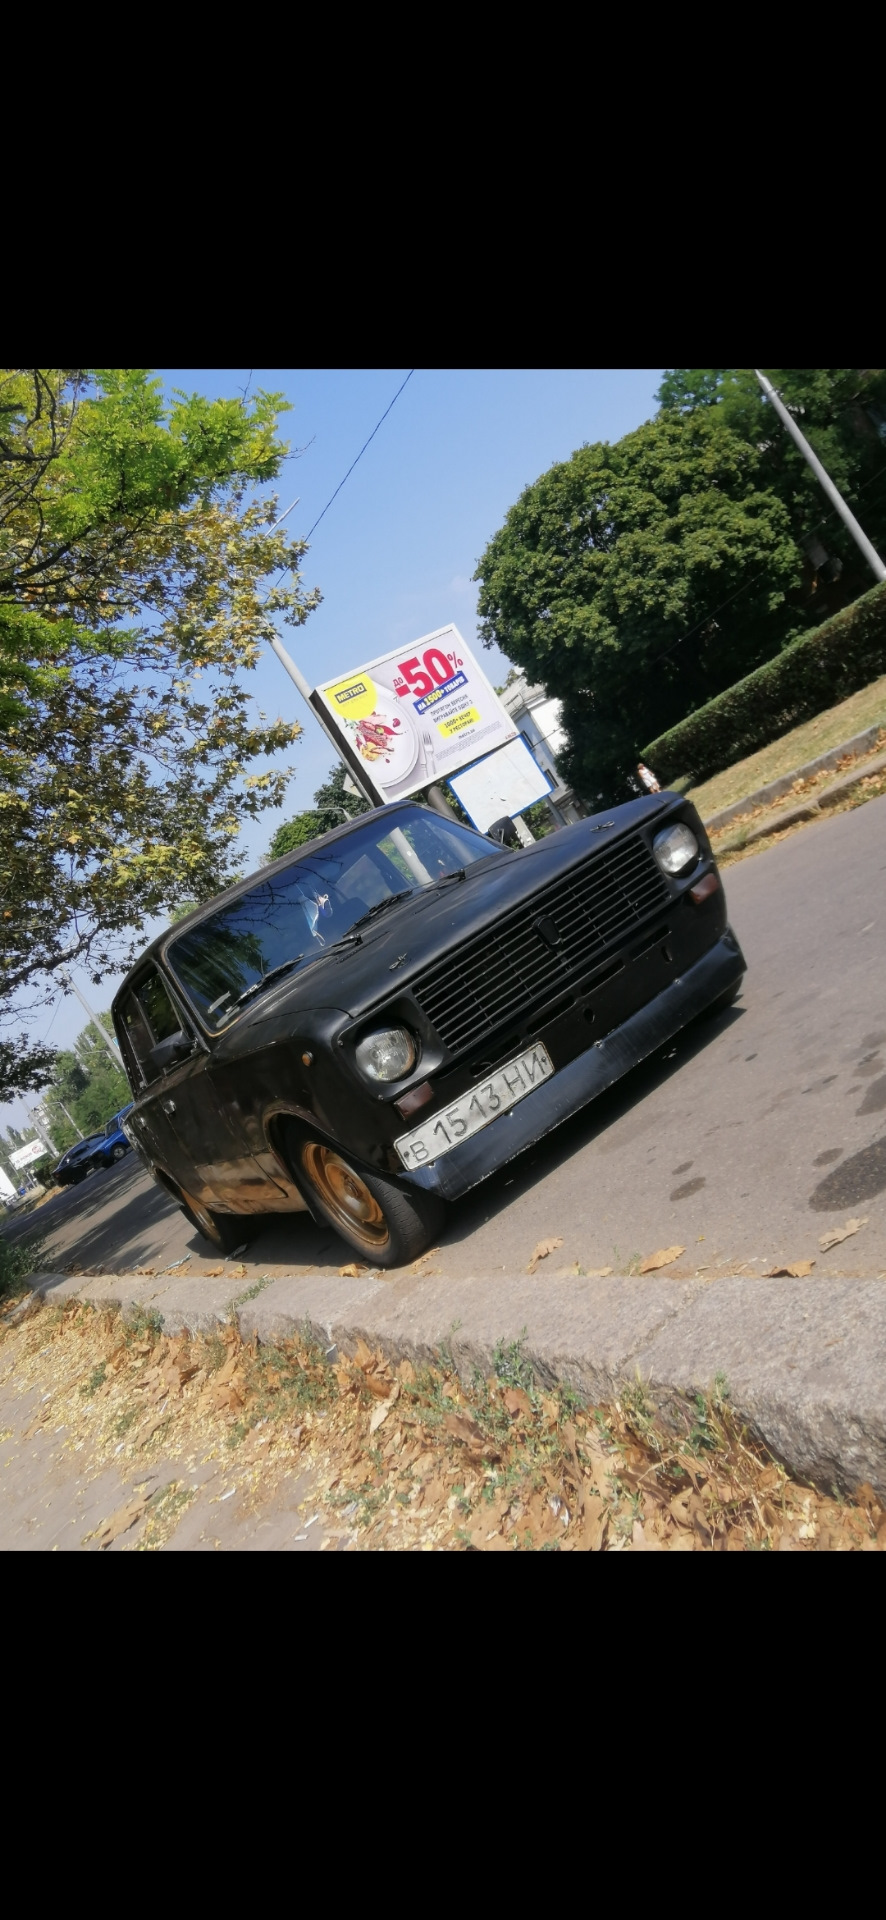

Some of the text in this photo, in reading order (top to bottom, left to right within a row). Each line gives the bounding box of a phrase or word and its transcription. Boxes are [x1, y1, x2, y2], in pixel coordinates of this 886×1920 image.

[336, 684, 366, 703] METRO
[417, 676, 465, 711] НА 1500+ ТОВАРІВ
[430, 694, 468, 716] ПРОТЯГОМ ВЕРЕСНЯ
[433, 708, 458, 723] ВИГРАВАЙТЕ
